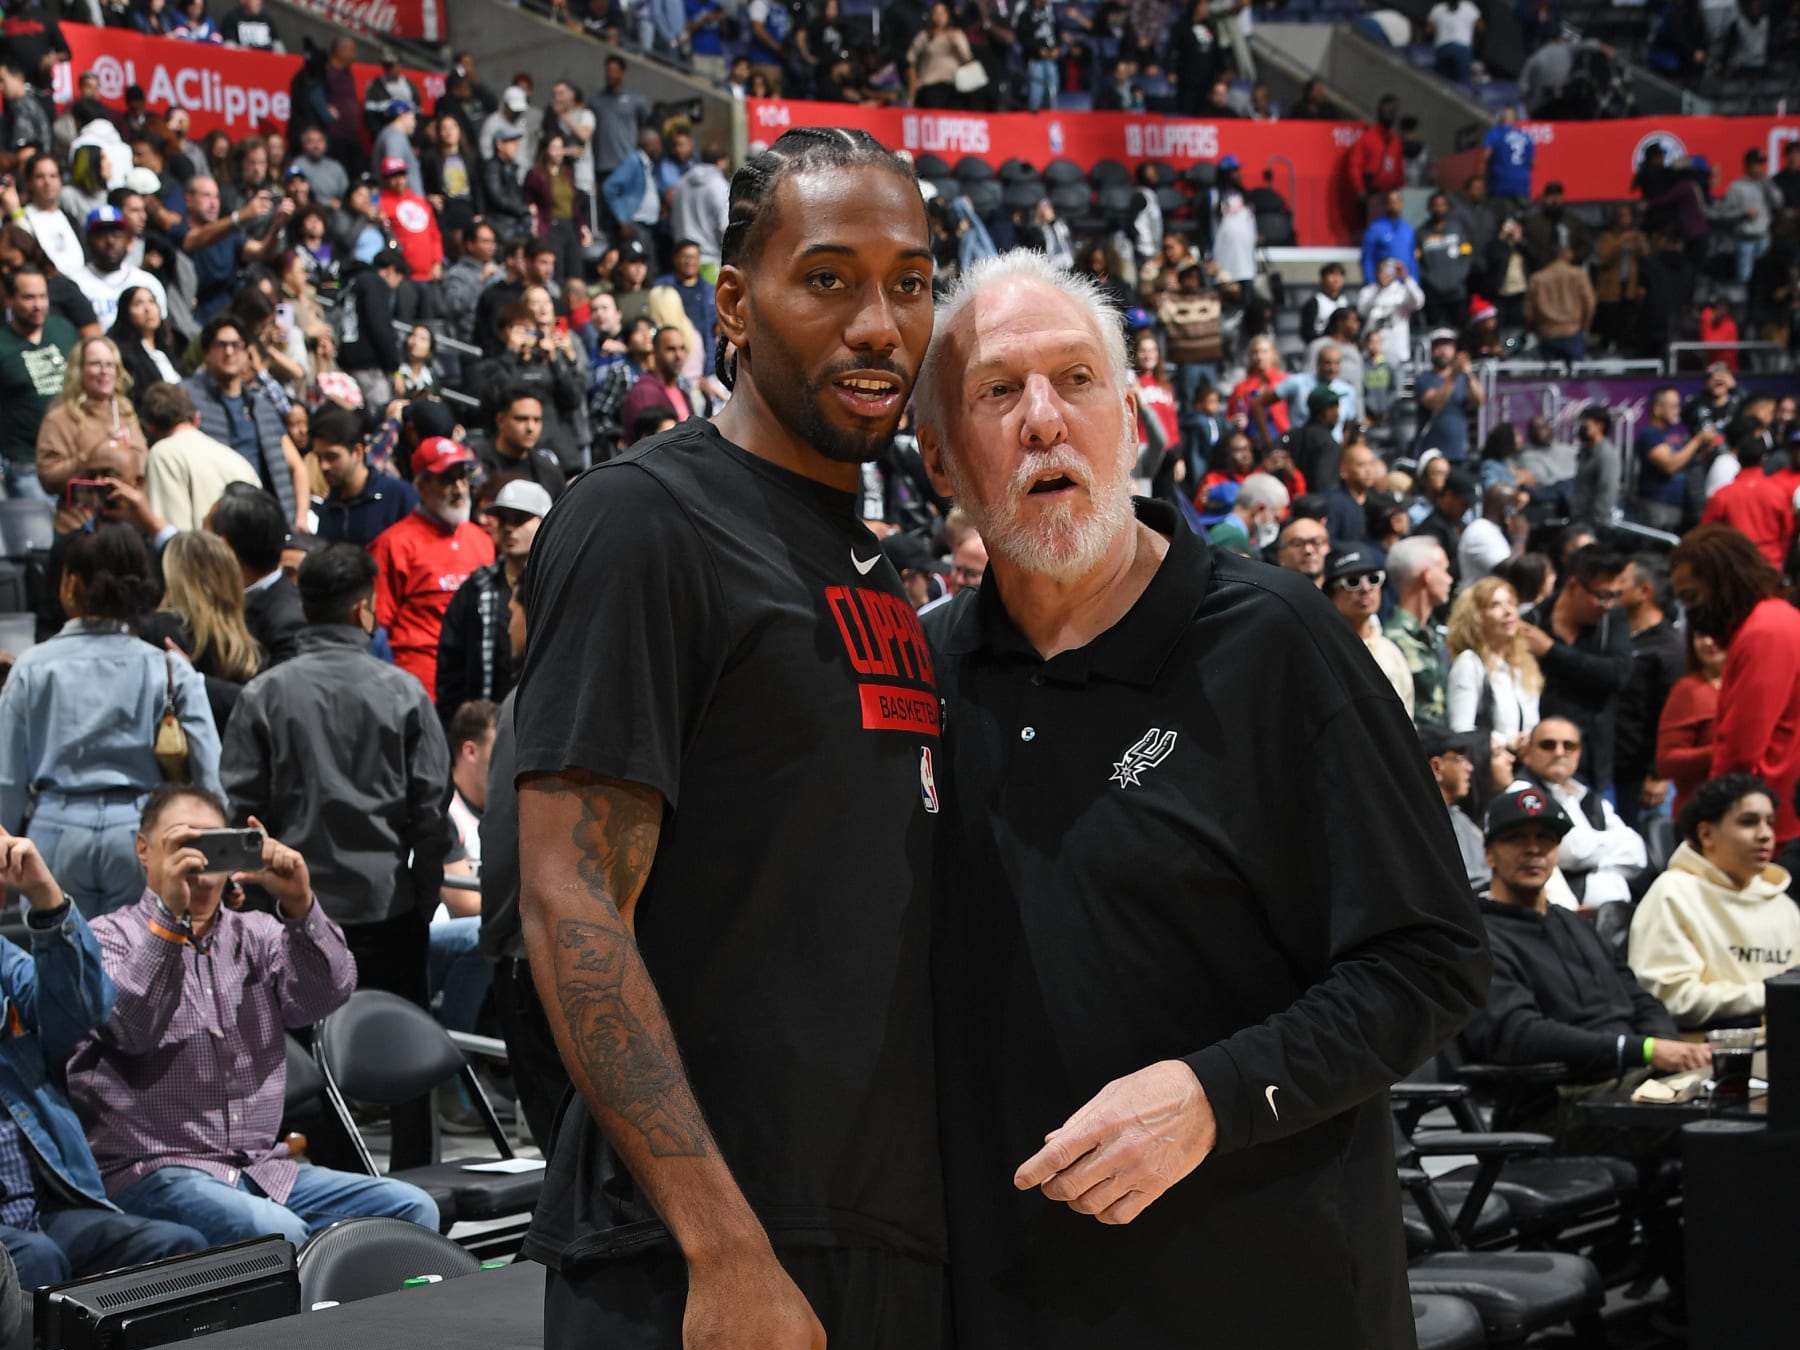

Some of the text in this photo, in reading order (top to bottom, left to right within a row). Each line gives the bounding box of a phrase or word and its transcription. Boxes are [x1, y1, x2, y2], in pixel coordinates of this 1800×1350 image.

[92, 55, 291, 128] @LAClippe
[756, 105, 790, 126] 104
[921, 116, 990, 153] CLIPPERS
[1145, 123, 1218, 157] CLIPPERS
[824, 585, 936, 690] CLIPPE
[879, 695, 938, 725] BASKETB
